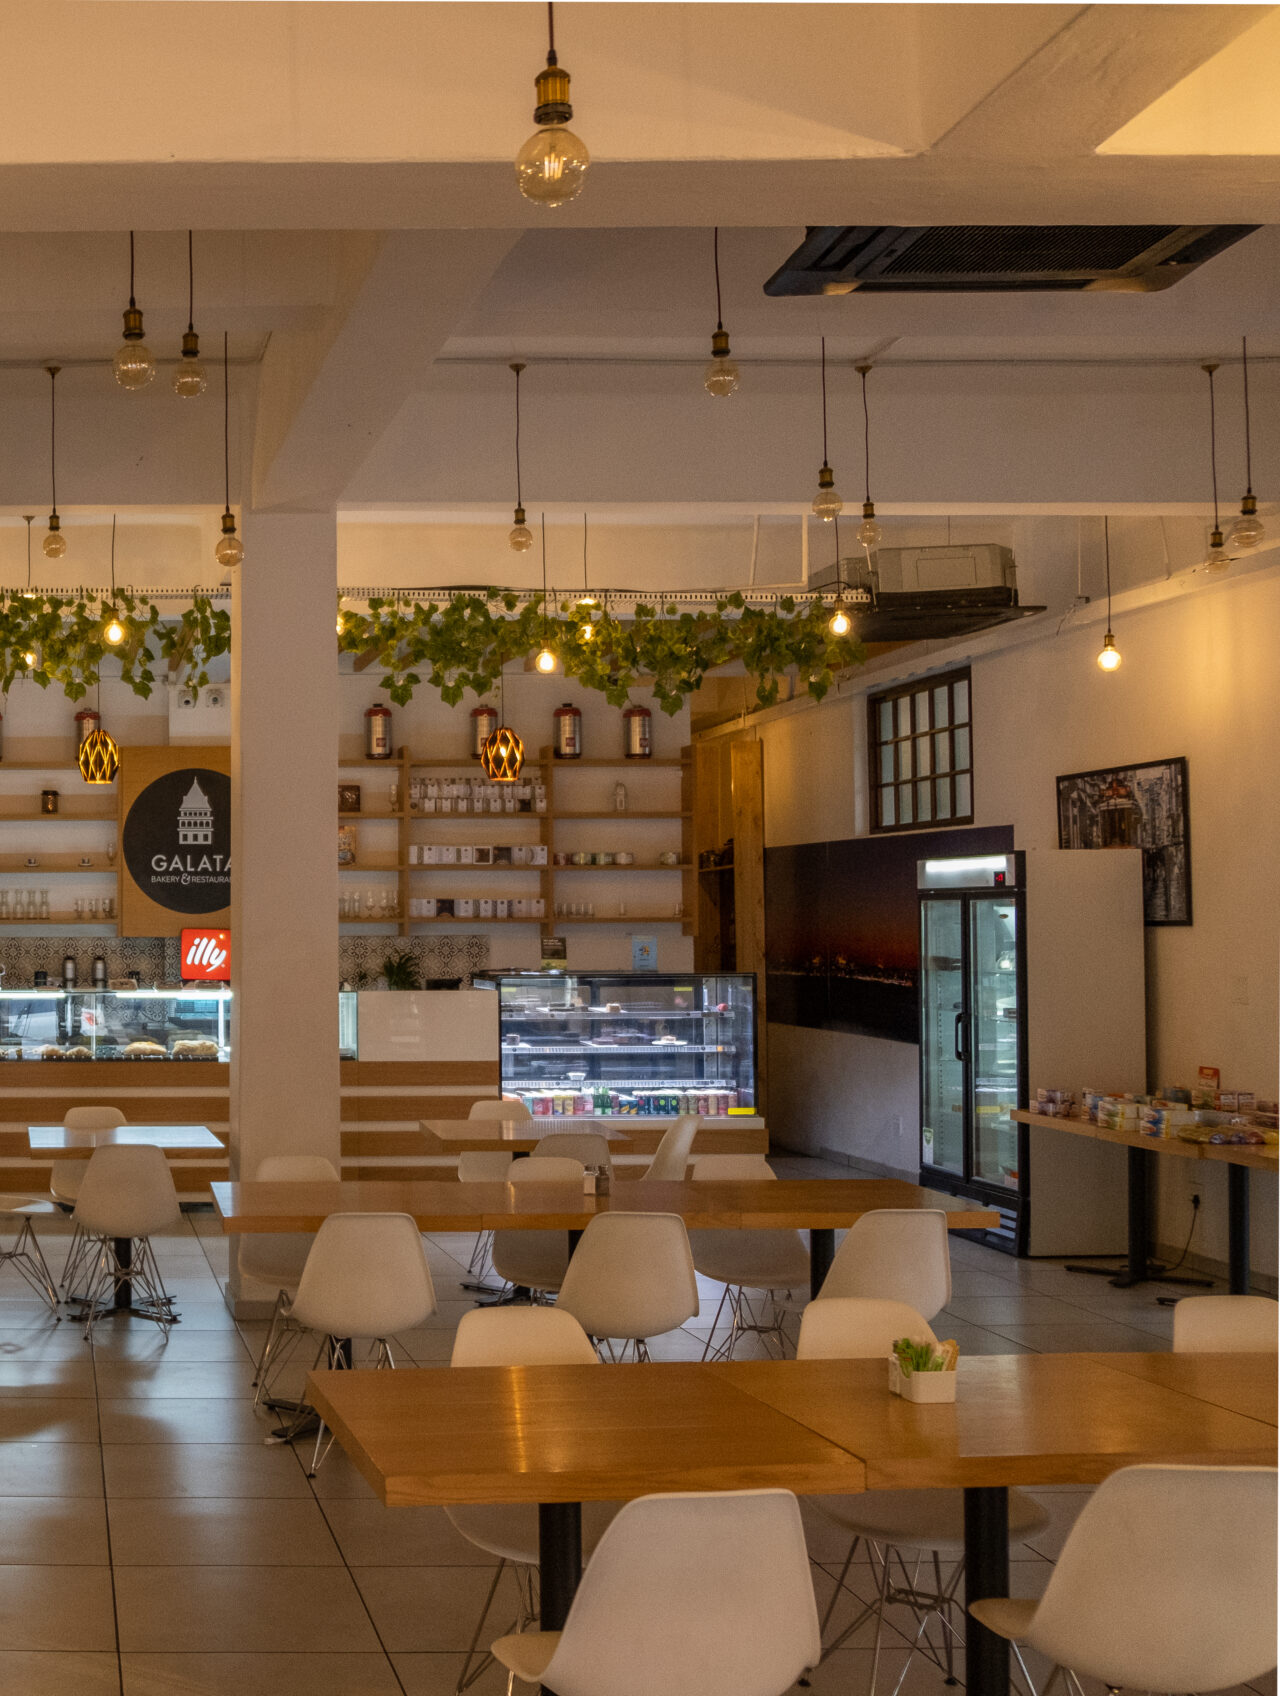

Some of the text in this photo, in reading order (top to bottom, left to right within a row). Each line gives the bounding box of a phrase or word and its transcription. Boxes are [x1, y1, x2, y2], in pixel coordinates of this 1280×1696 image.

[151, 873, 231, 885] BAKERY & RESTAURA
[186, 937, 227, 972] illy
